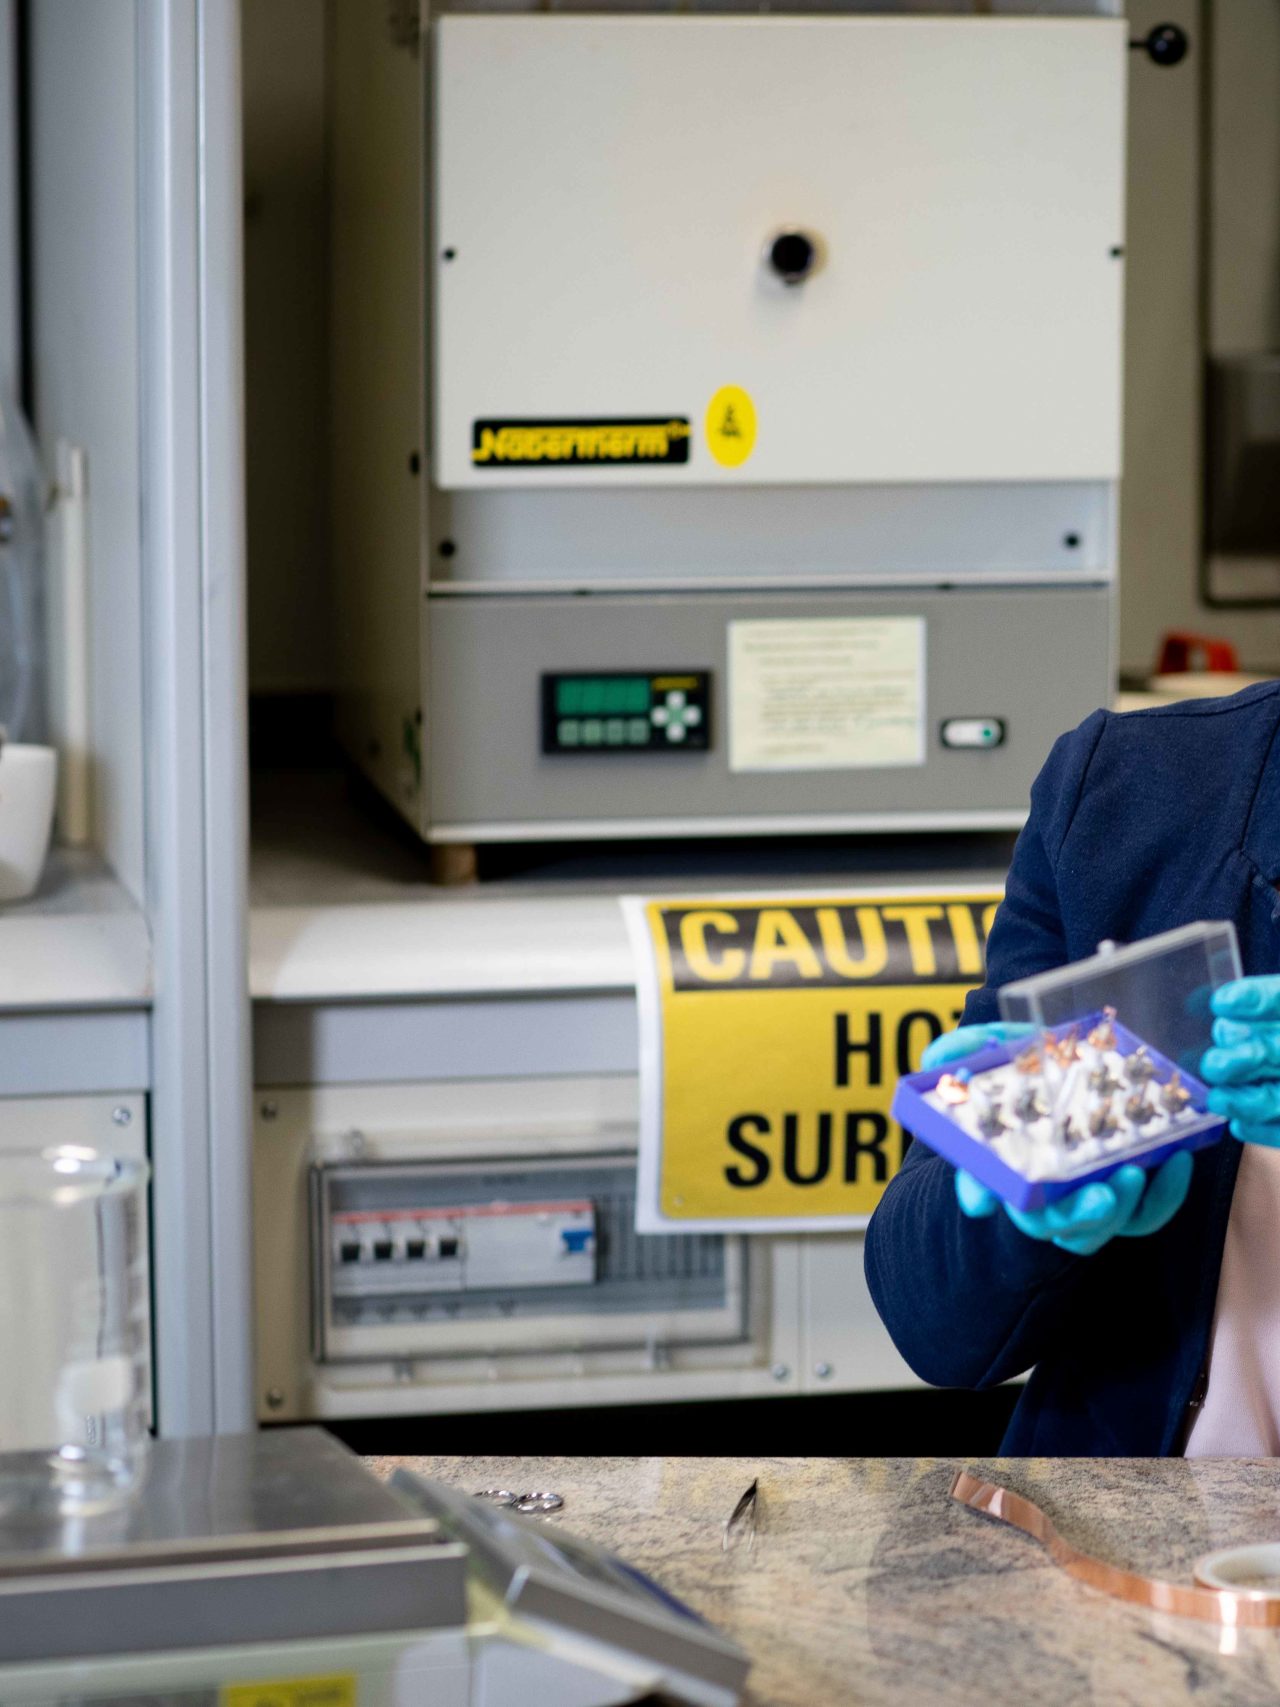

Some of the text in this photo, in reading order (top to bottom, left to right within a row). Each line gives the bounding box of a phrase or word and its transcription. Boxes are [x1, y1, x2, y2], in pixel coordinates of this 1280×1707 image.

[679, 904, 999, 982] CAUTI
[834, 1009, 965, 1088] HO
[723, 1111, 913, 1188] SUR
